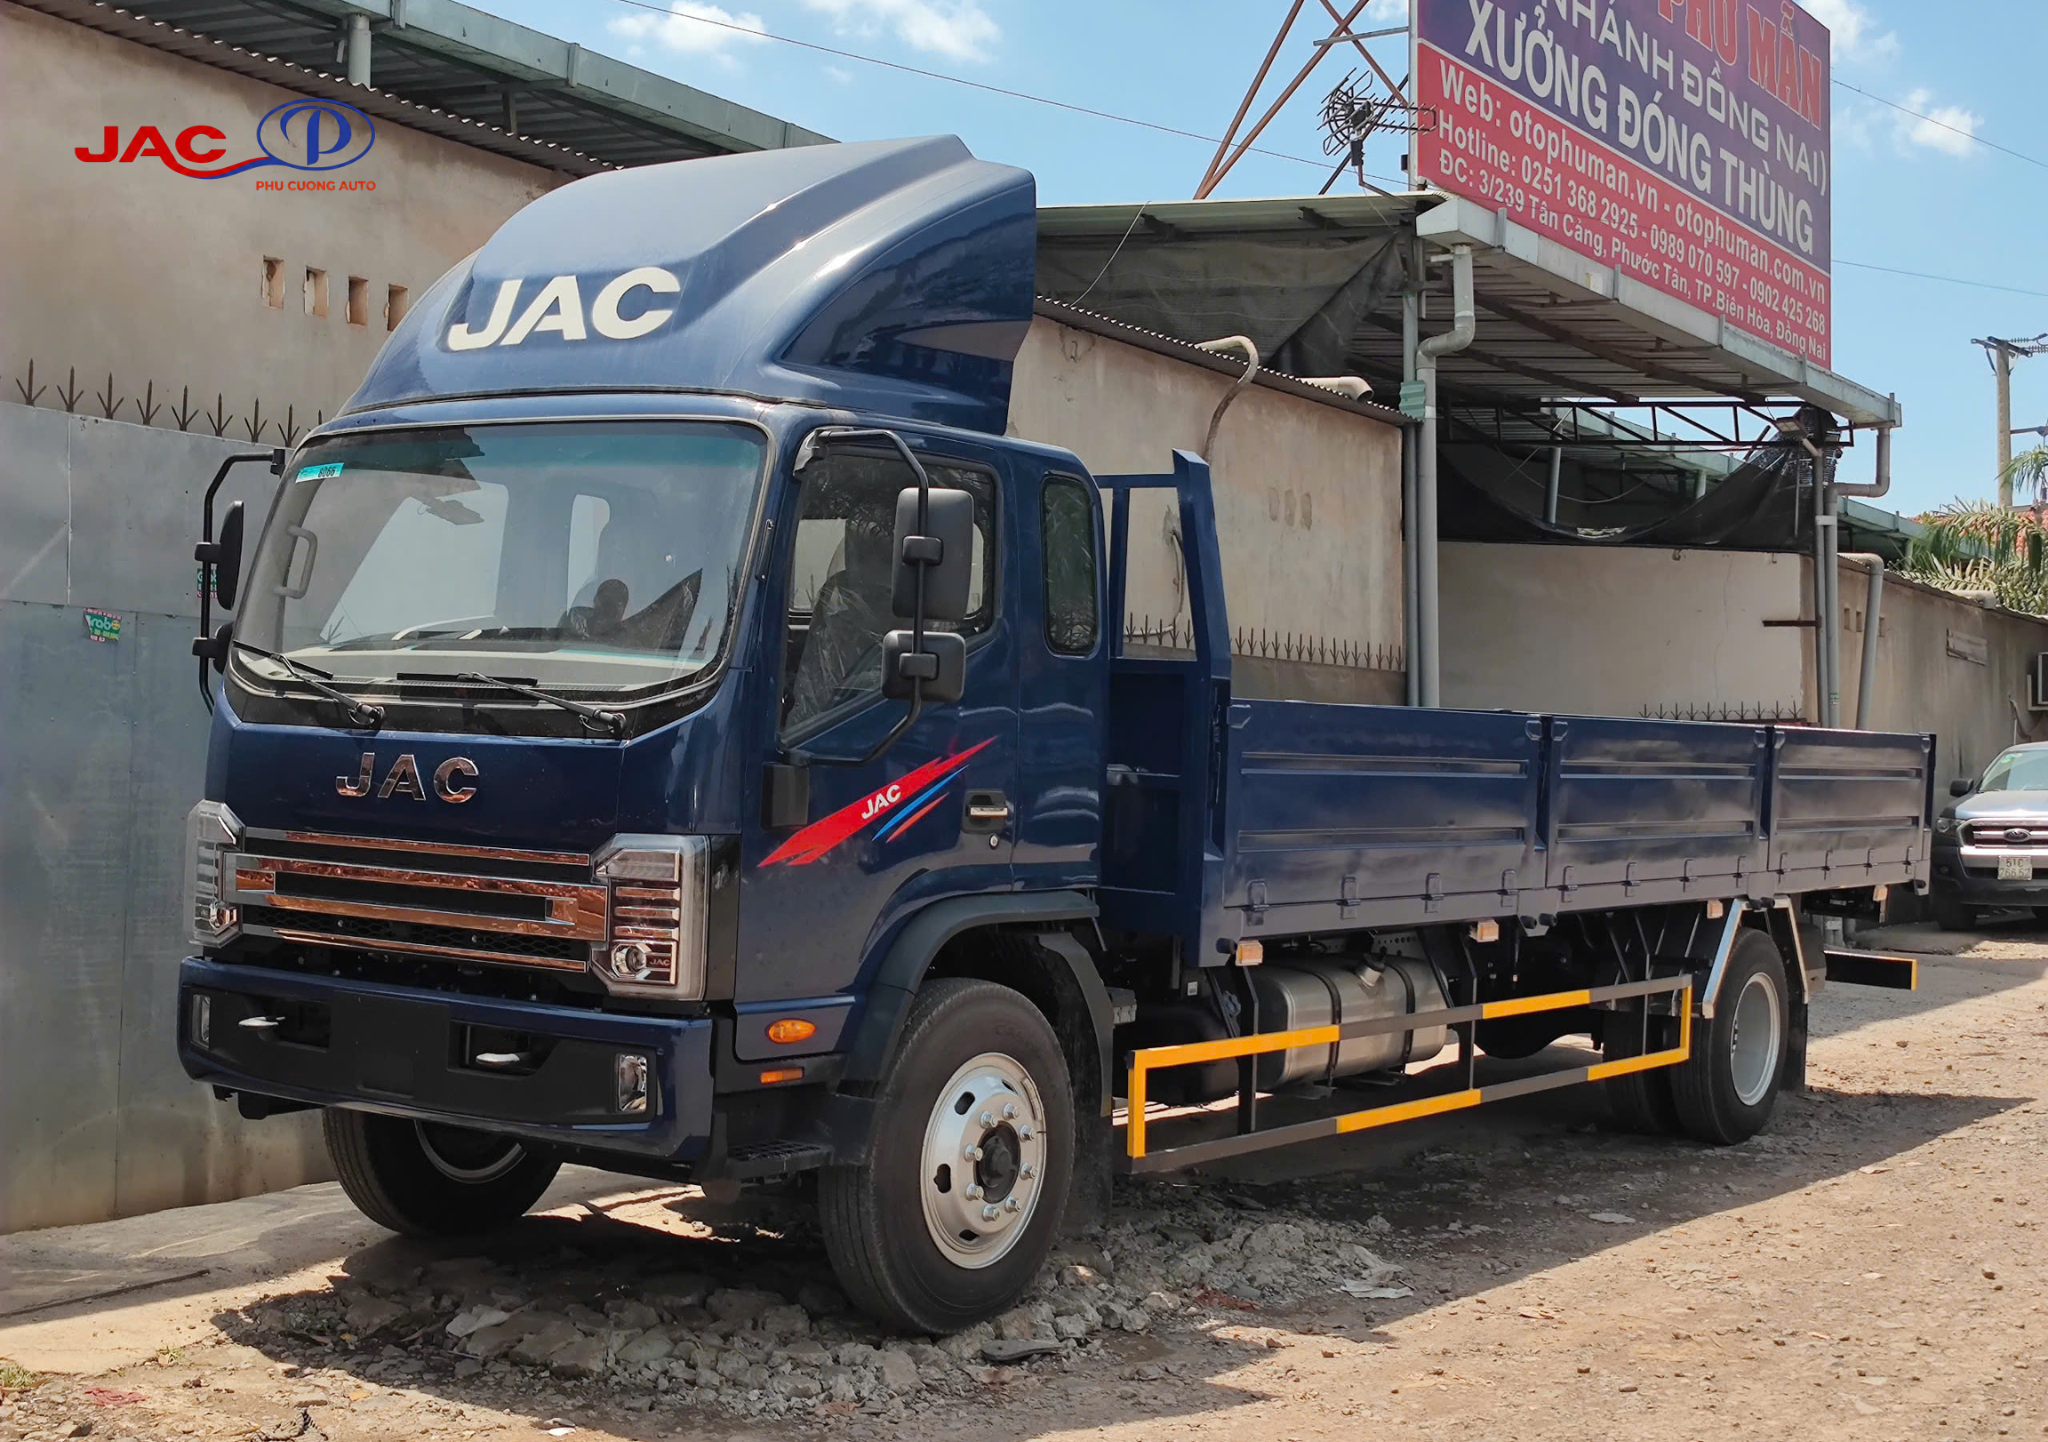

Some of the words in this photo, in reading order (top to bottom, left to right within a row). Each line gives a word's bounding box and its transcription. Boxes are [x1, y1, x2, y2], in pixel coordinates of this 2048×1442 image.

[1465, 0, 1607, 133] XƯỞNG
[1618, 84, 1712, 195] ĐÓNG
[1720, 147, 1813, 255] THÙNG
[1681, 59, 1769, 152] ĐỒNG
[1776, 124, 1827, 197] NAI)
[1747, 0, 1822, 131] MẪN
[1439, 109, 1517, 177] Hotline:
[1522, 155, 1562, 200] 0251
[1567, 180, 1597, 218] 368
[1601, 197, 1639, 239] 2925
[1650, 224, 1685, 263] 0989
[1688, 244, 1713, 278] 070
[1716, 258, 1740, 290] 597
[1750, 276, 1780, 313] 0902
[1781, 294, 1803, 325] 425
[1805, 306, 1826, 336] 268
[1440, 59, 1501, 127] Web:
[1510, 110, 1658, 213] otophuman.vn
[1675, 202, 1825, 304] otophuman.com.vn
[448, 267, 681, 351] JAC
[1440, 148, 1474, 188] ĐC:
[1479, 169, 1525, 213] 3/239
[1528, 194, 1559, 231] Tân
[1562, 214, 1607, 258] Cảng,
[1611, 237, 1660, 280] Phước
[1663, 261, 1692, 300] Tân,
[1747, 305, 1774, 339] Hòa,
[1776, 319, 1807, 354] Đồng
[1808, 336, 1826, 361] Nai
[336, 752, 479, 804] JAC
[861, 784, 902, 819] JAC
